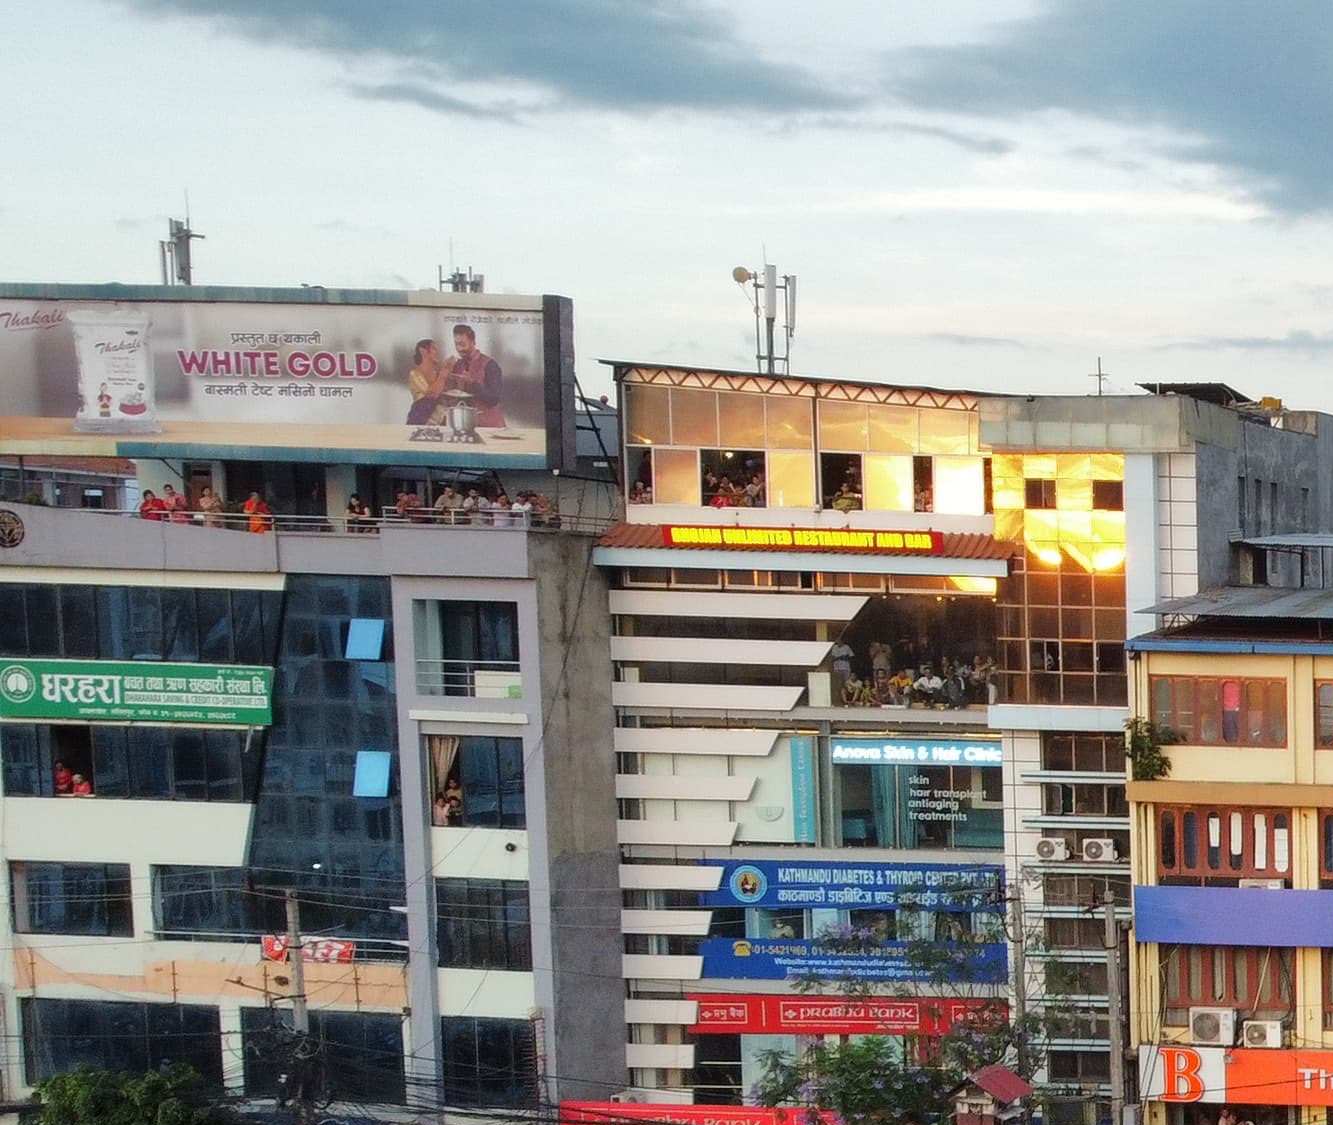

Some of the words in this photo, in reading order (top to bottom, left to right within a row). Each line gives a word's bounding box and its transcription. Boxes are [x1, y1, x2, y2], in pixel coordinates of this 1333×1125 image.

[177, 350, 280, 377] WHITE
[287, 351, 377, 378] GOLD
[833, 745, 881, 760] Anova
[883, 745, 915, 761] Skin
[917, 746, 929, 761] &
[931, 746, 961, 762] Hair
[964, 747, 1002, 762] Clinic
[908, 775, 930, 786] skin
[909, 788, 931, 797] hair
[934, 788, 988, 801] transplant
[908, 799, 960, 812] antiaging
[909, 811, 968, 822] treatments
[778, 868, 832, 883] KATHMANDU
[833, 870, 875, 885] DIABETES
[876, 871, 883, 884] &
[1159, 1047, 1205, 1102] B
